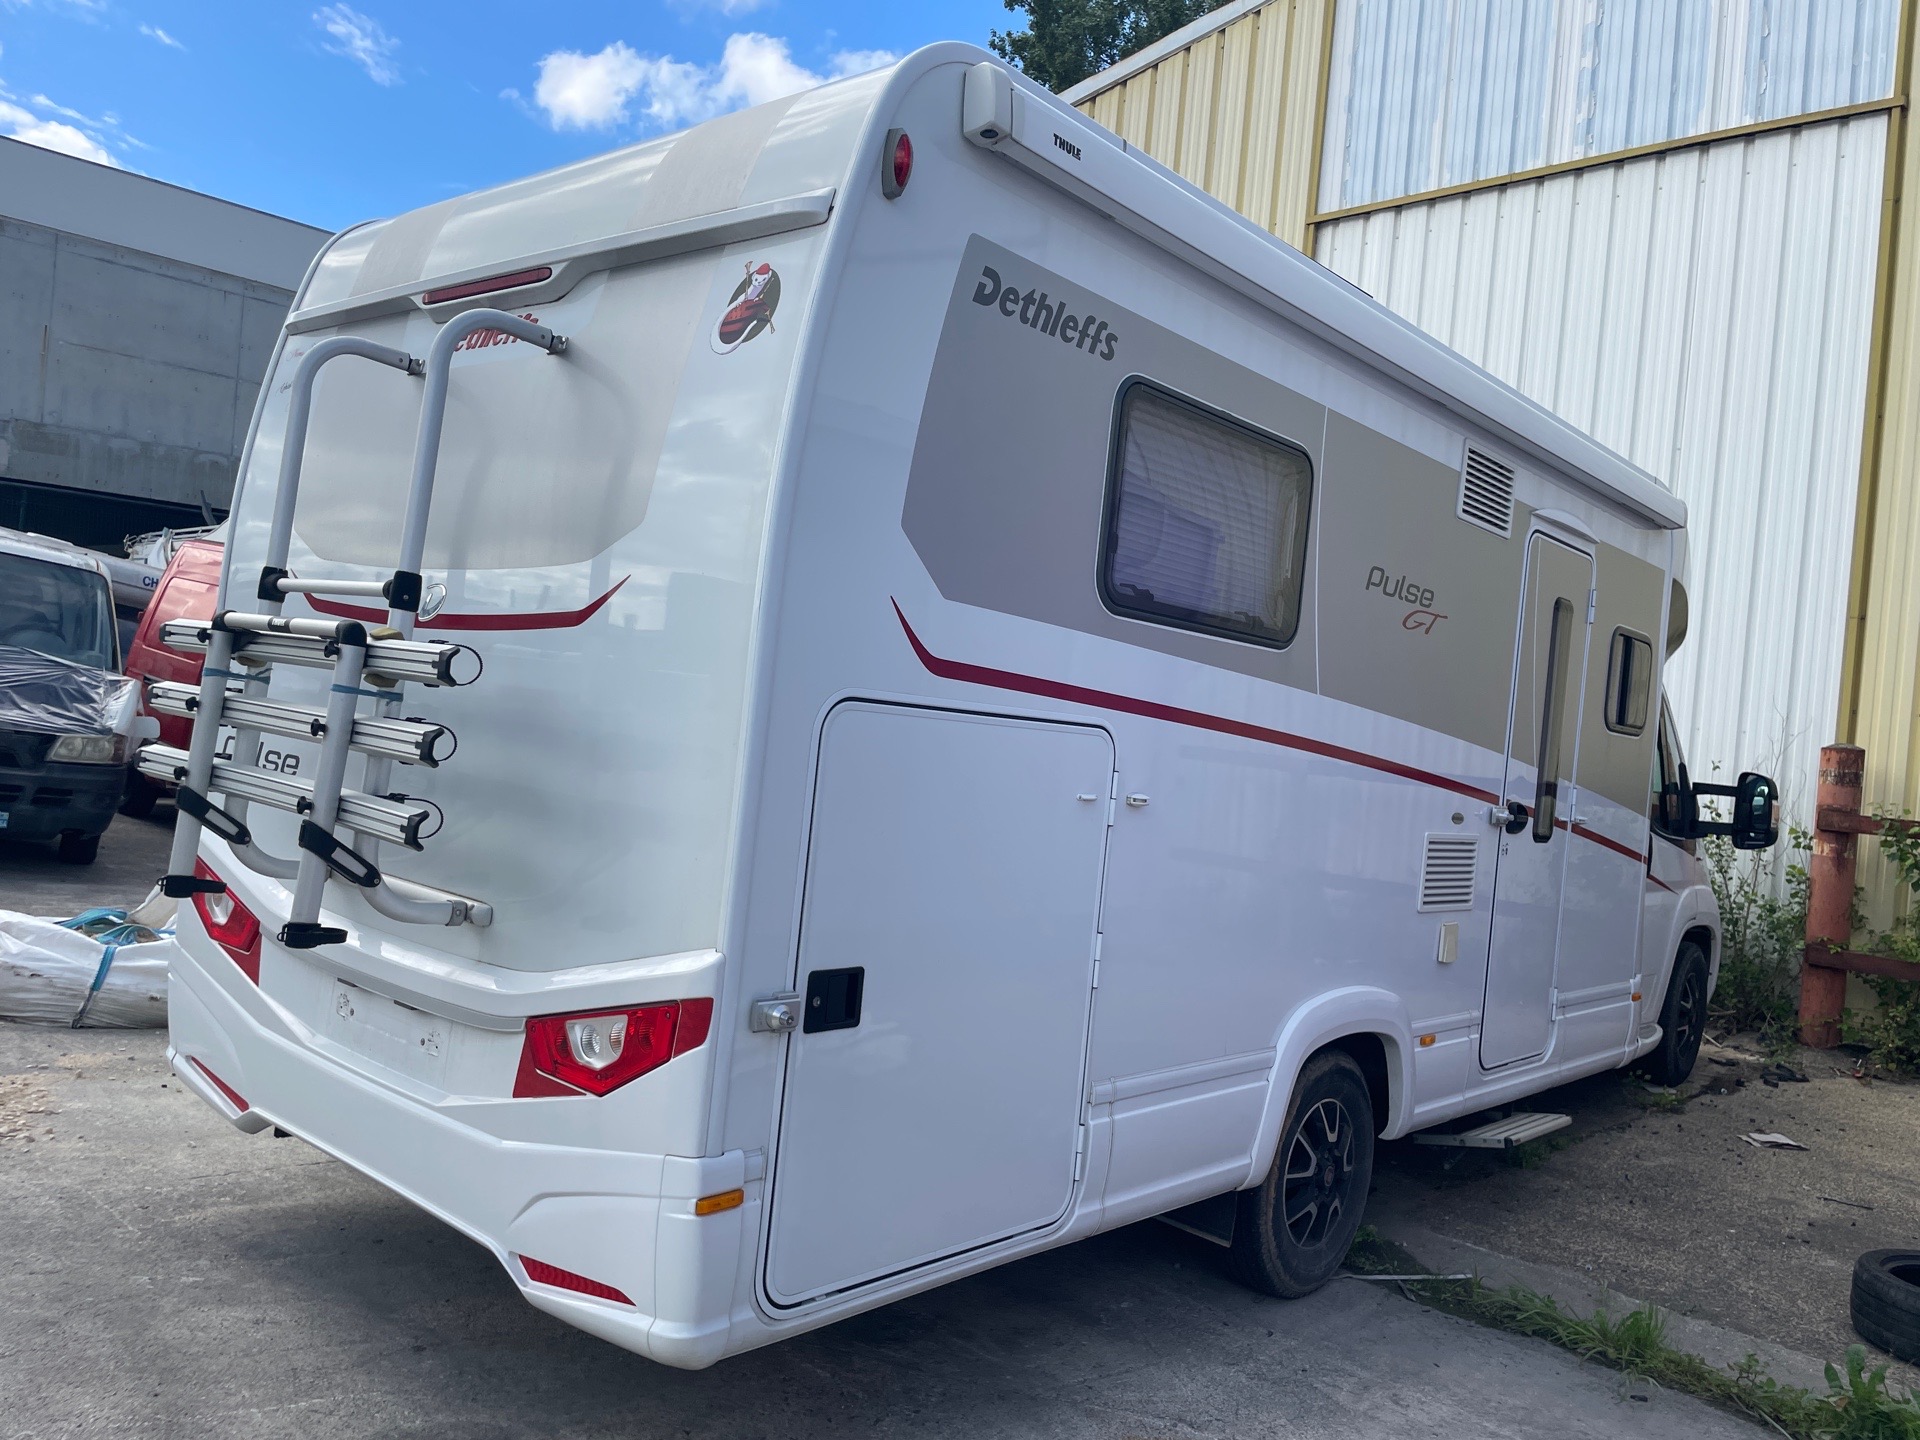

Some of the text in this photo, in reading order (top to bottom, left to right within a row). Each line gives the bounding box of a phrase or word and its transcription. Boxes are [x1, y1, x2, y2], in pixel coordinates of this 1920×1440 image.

[1053, 132, 1082, 161] THULE
[972, 265, 1119, 361] Dethleffs
[1402, 609, 1449, 635] GT
